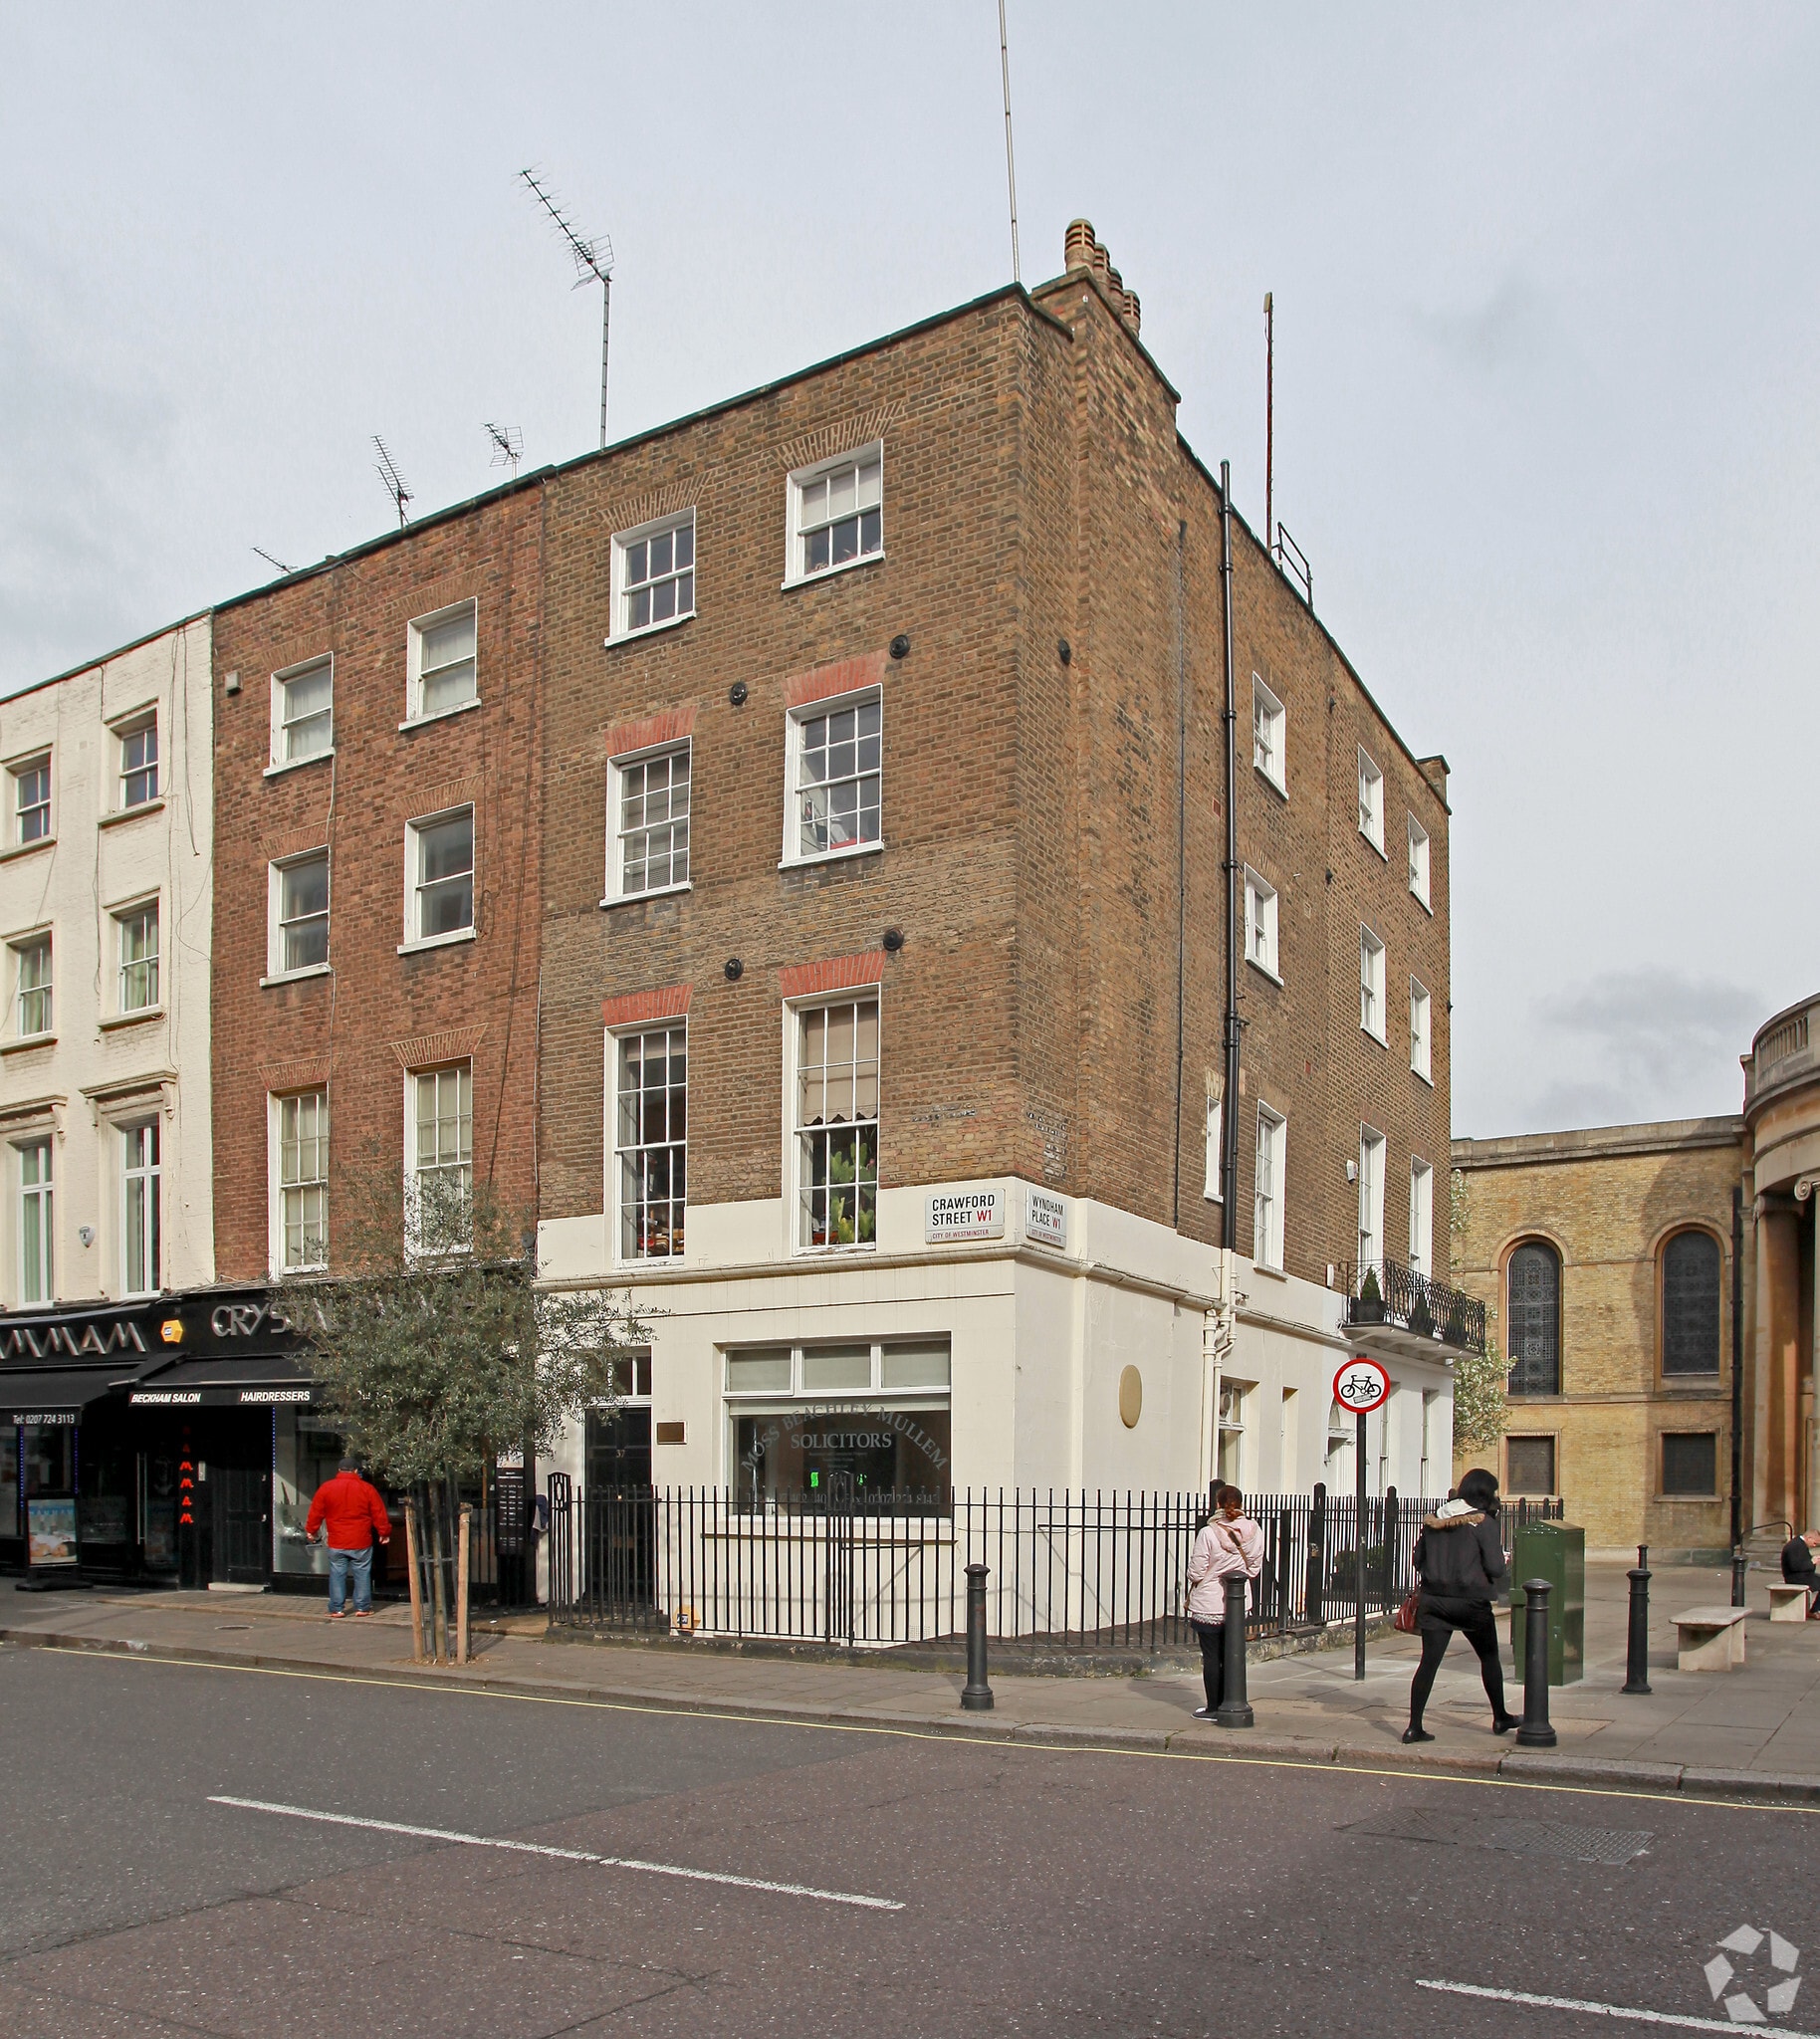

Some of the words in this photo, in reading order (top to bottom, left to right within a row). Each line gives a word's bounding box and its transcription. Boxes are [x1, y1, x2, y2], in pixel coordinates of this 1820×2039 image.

[932, 1194, 995, 1212] CRAWFORD
[1031, 1194, 1064, 1216] WYNDHAM
[932, 1211, 972, 1227] STREET
[977, 1209, 992, 1223] W1
[1031, 1209, 1050, 1227] PLACE
[1052, 1216, 1061, 1231] W1
[953, 1229, 989, 1238] WESTMINSTER
[131, 1393, 172, 1404] BECKHAM
[171, 1393, 202, 1403] SALON
[240, 1391, 311, 1402] HAIRDRESSERS
[12, 1414, 25, 1425] Tel:
[25, 1414, 42, 1425] 0207
[43, 1414, 57, 1424] 724
[57, 1414, 76, 1424] 3113
[741, 1425, 780, 1472] MOSS
[782, 1403, 873, 1431] BEACHLEY
[876, 1405, 948, 1471] MULLEM
[791, 1433, 892, 1449] SOLICITORS
[615, 1449, 626, 1459] 37
